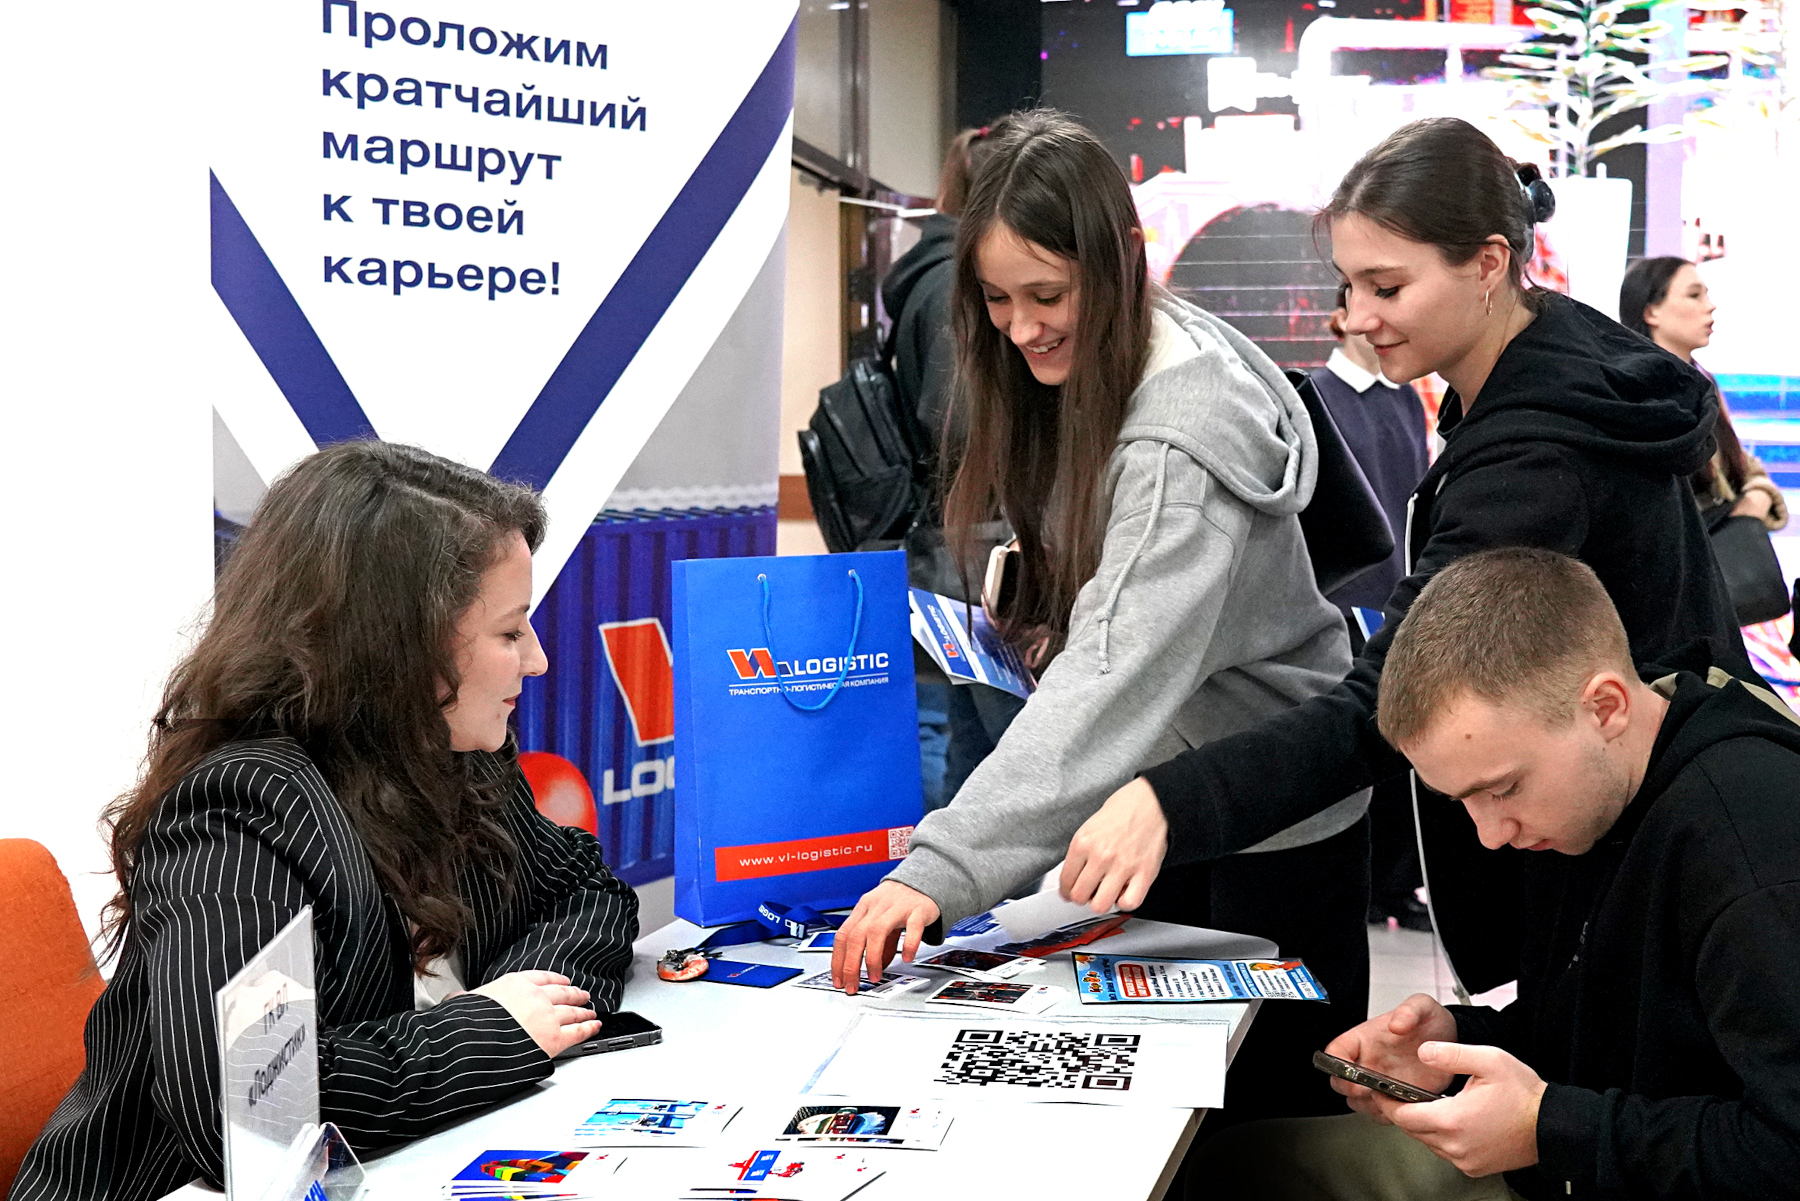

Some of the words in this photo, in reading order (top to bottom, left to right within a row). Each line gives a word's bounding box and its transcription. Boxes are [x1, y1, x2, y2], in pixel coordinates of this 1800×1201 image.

[322, 0, 608, 70] Проложим
[321, 68, 647, 132] кратчайший
[322, 131, 562, 186] маршрут
[323, 193, 354, 222] к
[372, 197, 525, 236] твоей
[323, 255, 561, 300] карьере!
[729, 680, 850, 696] ТРАНСПОРТНО-ЛОГИСТИЧЕСАЯ
[850, 676, 889, 688] КОМПАНИЯ
[794, 652, 889, 676] LOGISTIC
[739, 844, 873, 867] www.vl-logistic.ru
